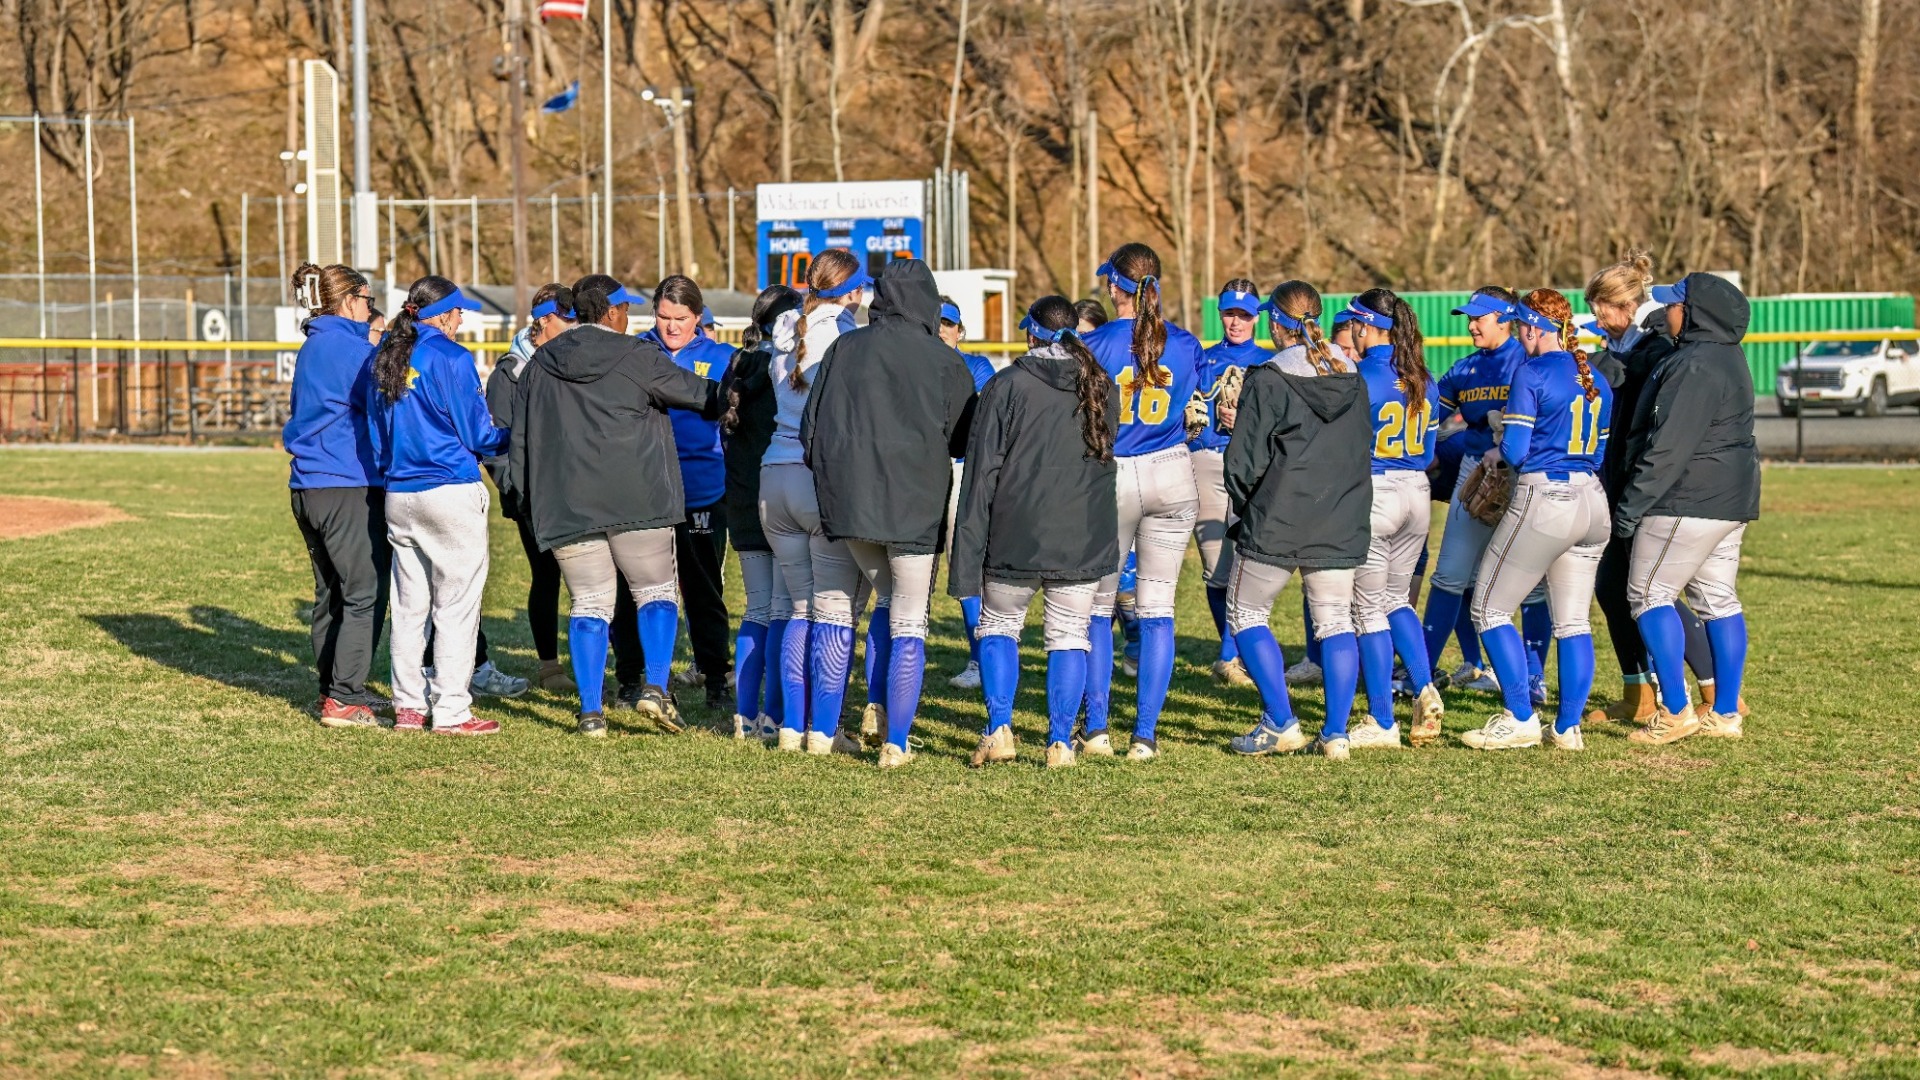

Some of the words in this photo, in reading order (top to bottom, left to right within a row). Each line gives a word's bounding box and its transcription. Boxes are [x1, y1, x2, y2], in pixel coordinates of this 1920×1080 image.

[760, 190, 829, 210] Widener
[836, 190, 918, 213] University
[772, 220, 797, 230] BALL
[823, 220, 856, 230] STRIKE
[769, 237, 810, 252] HOME
[866, 236, 911, 251] GUEST
[694, 360, 711, 377] W
[1115, 365, 1173, 425] 16
[1458, 385, 1511, 403] WIDENE
[1374, 398, 1432, 459] 20
[1567, 394, 1603, 455] 11
[692, 511, 710, 529] W
